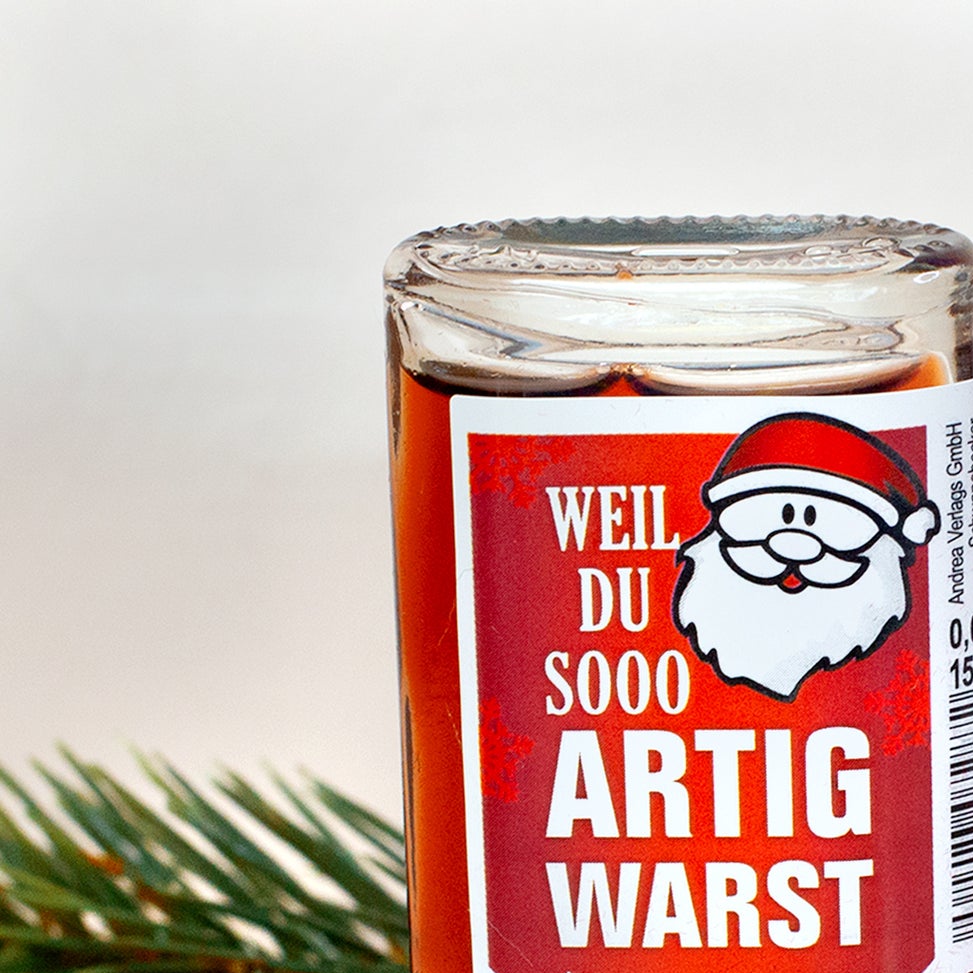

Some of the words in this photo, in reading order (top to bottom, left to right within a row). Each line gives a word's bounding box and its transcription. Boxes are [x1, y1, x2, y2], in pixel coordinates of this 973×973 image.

[945, 422, 963, 477] GmbH
[545, 485, 681, 551] WEIL
[947, 481, 967, 544] Verlags
[577, 567, 650, 632] DU
[948, 546, 964, 604] Andrea
[544, 650, 691, 715] SOOO
[545, 726, 872, 839] ARTIG
[545, 859, 875, 949] WARST
